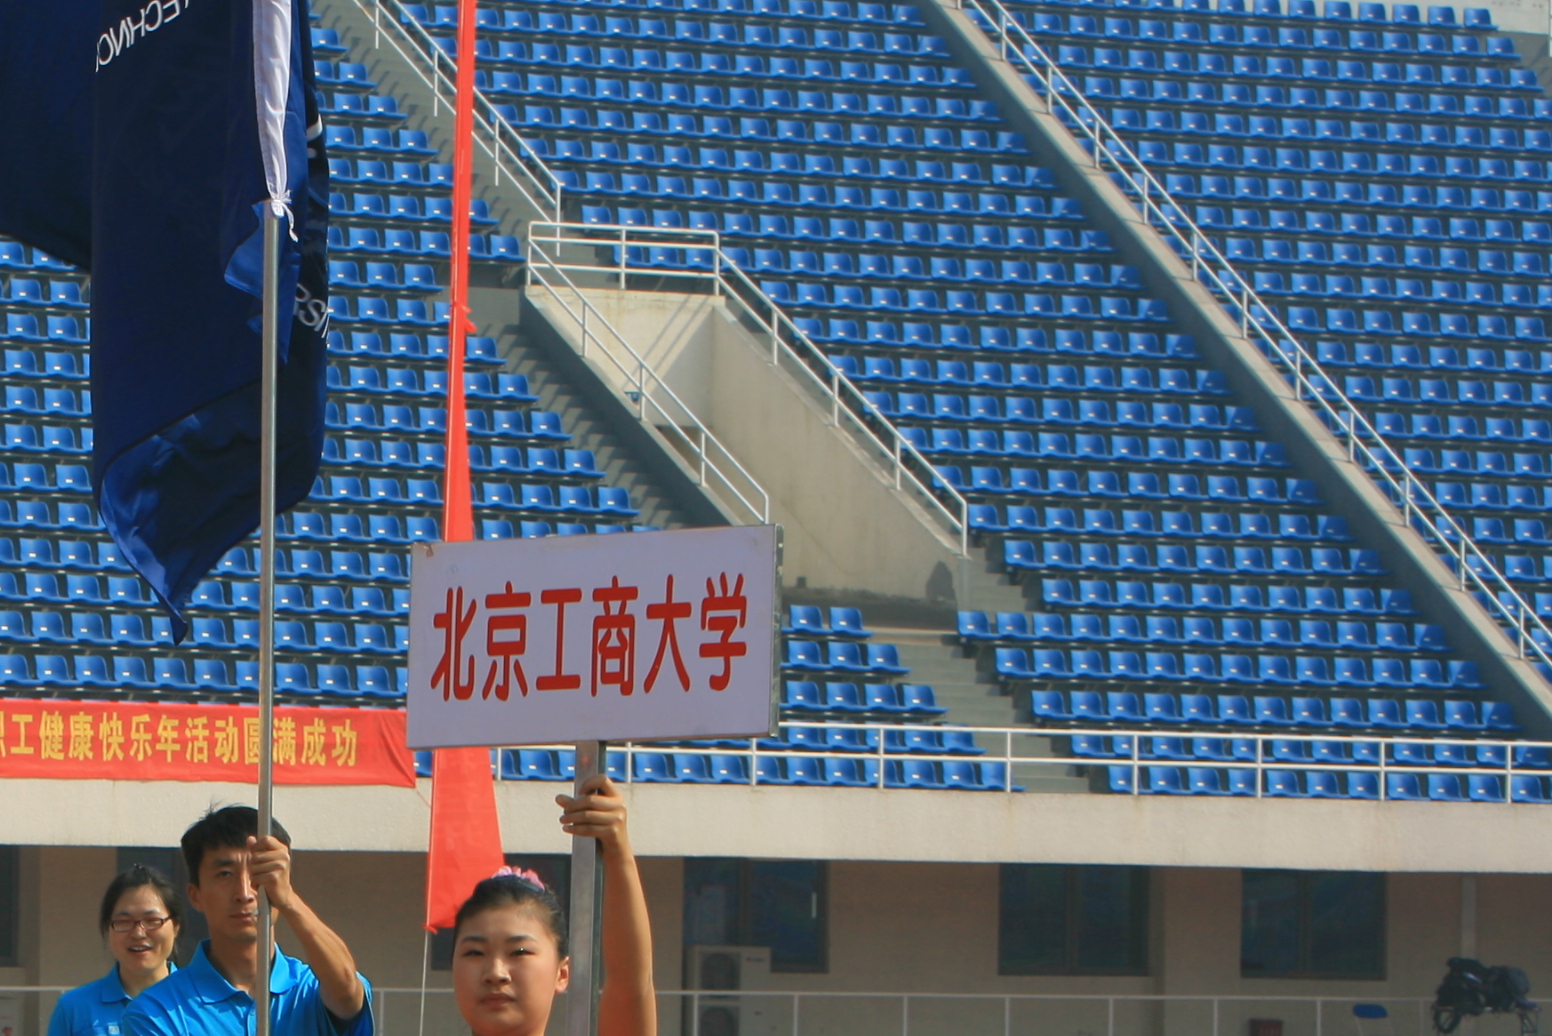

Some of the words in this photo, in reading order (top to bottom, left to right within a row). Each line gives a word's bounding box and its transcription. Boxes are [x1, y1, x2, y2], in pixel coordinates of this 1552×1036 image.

[430, 571, 748, 702] 北京工商大学
